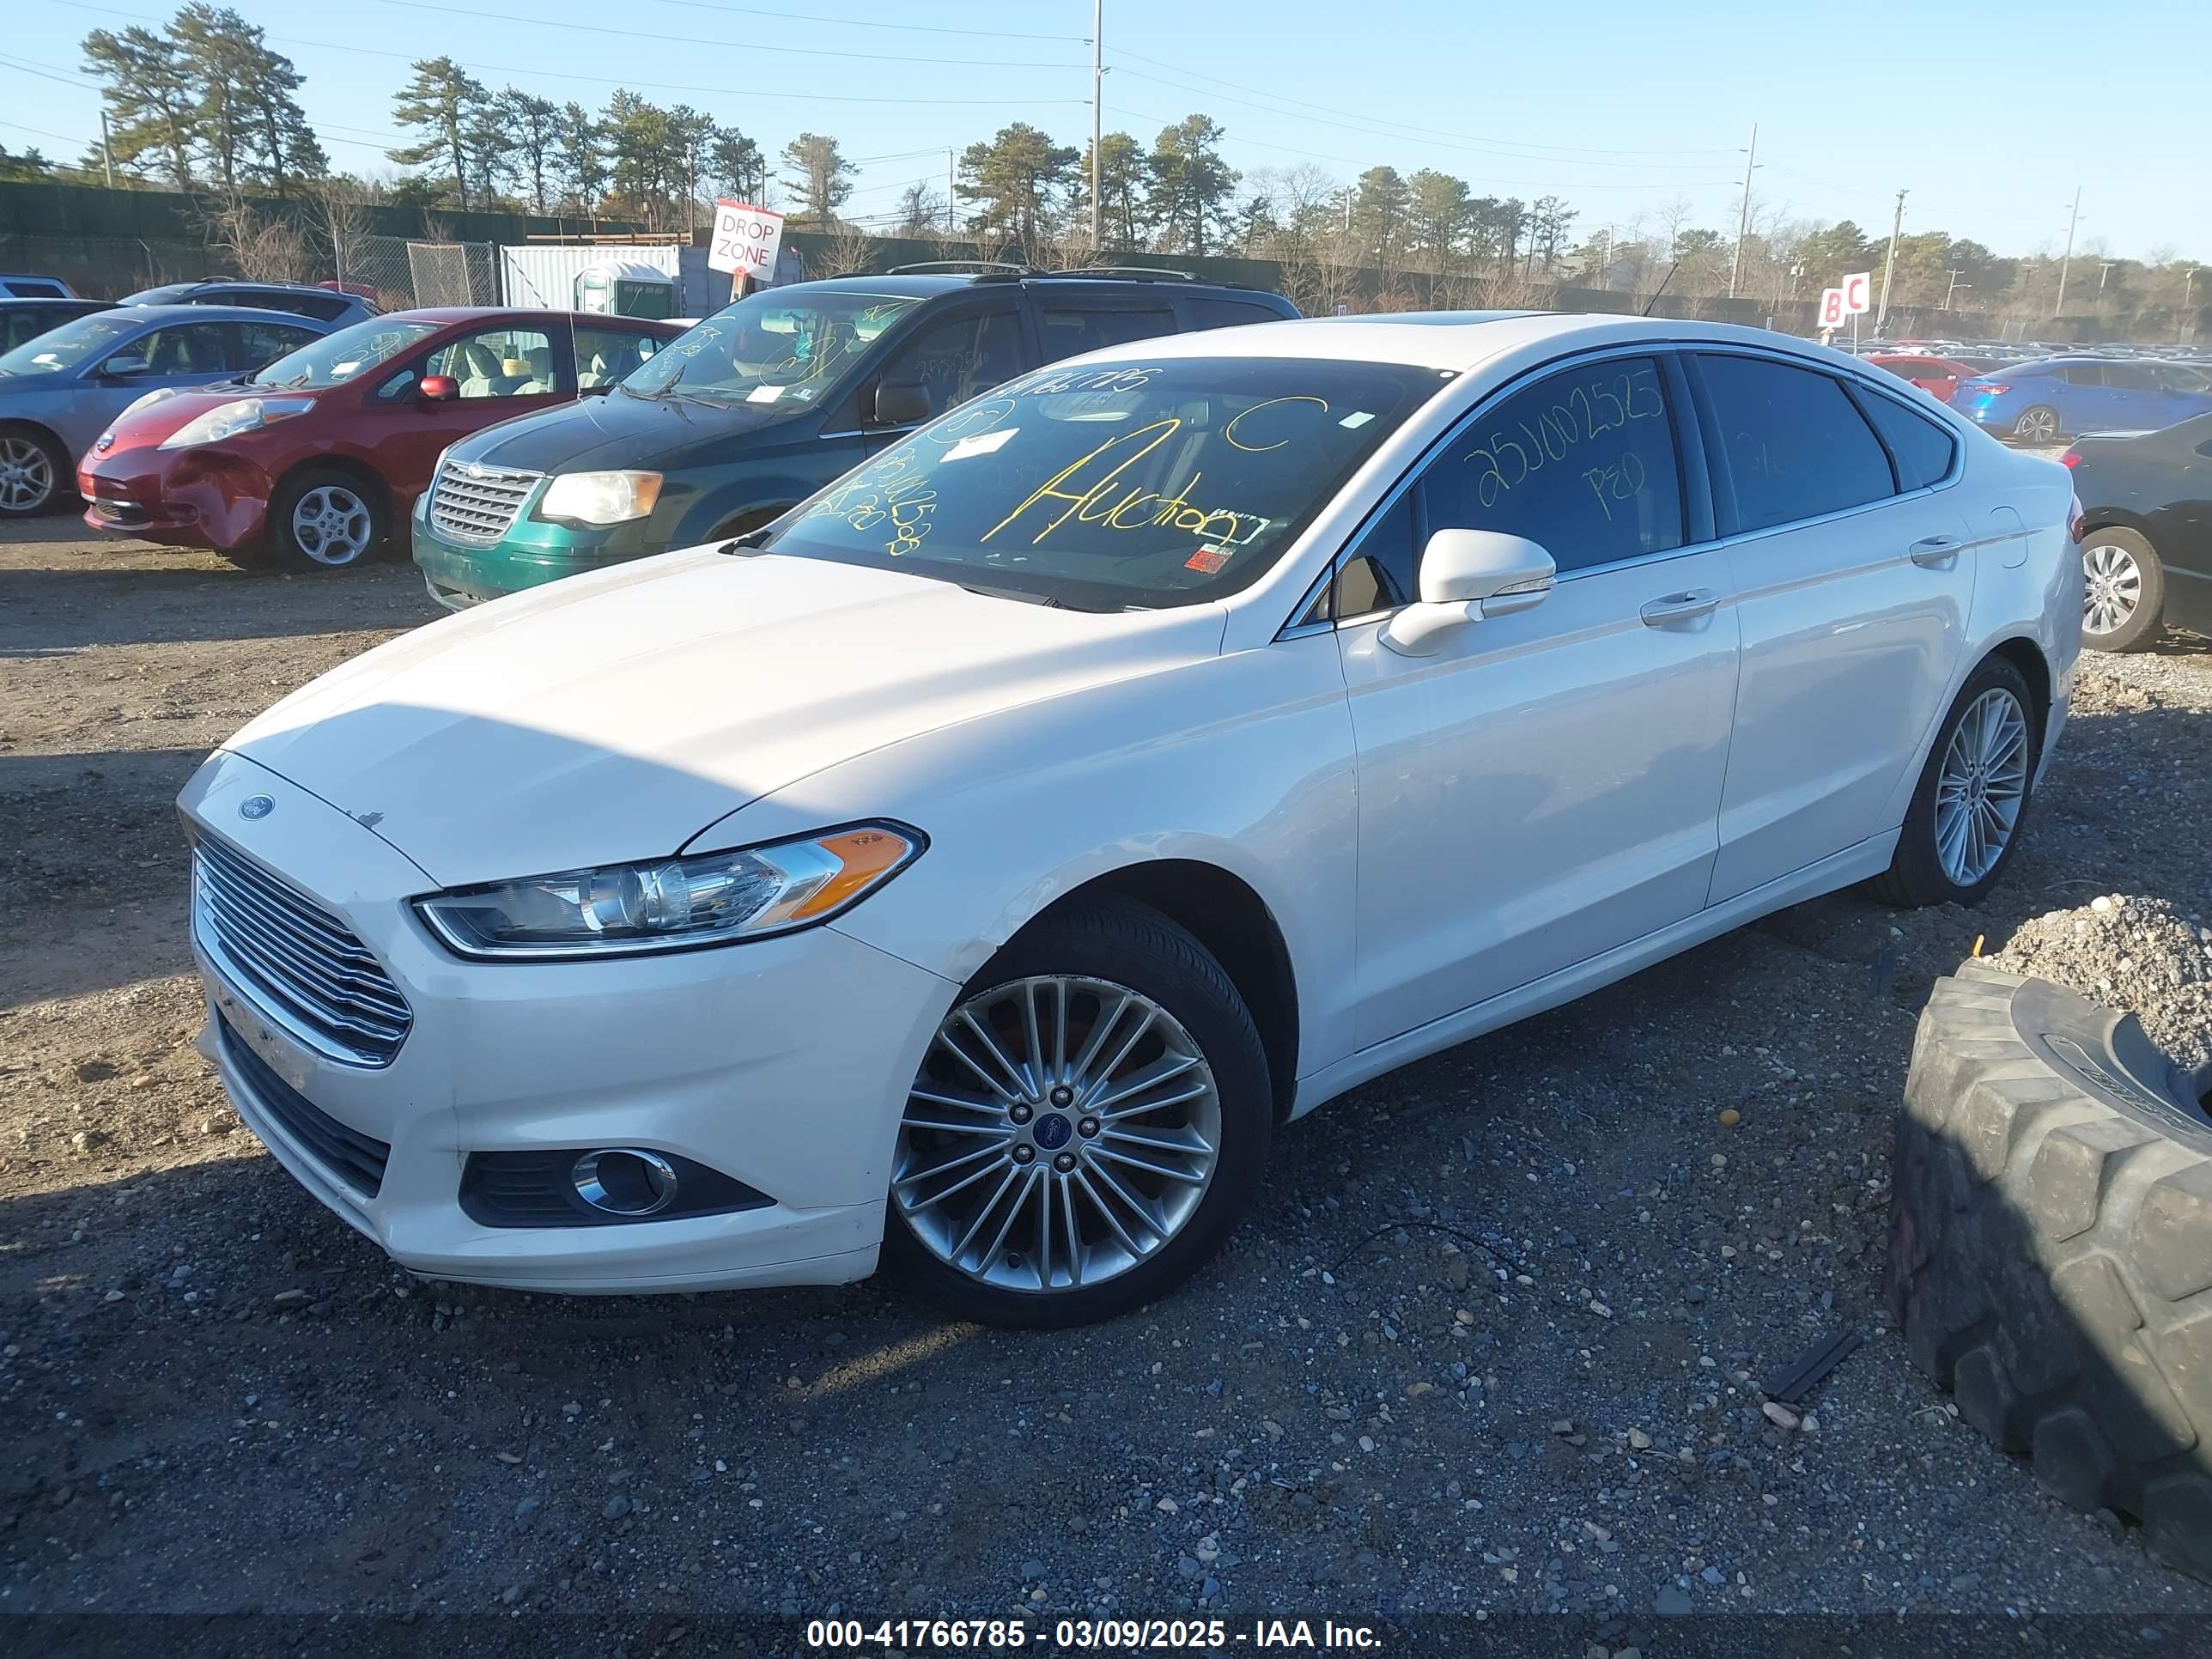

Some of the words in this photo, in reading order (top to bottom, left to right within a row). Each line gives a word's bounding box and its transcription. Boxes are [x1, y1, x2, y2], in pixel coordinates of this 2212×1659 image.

[722, 215, 775, 241] DROP
[718, 238, 770, 267] ZONE
[1826, 292, 1842, 323] B
[1848, 278, 1863, 310] C
[1225, 396, 1328, 452] C
[980, 418, 1237, 546] Auction
